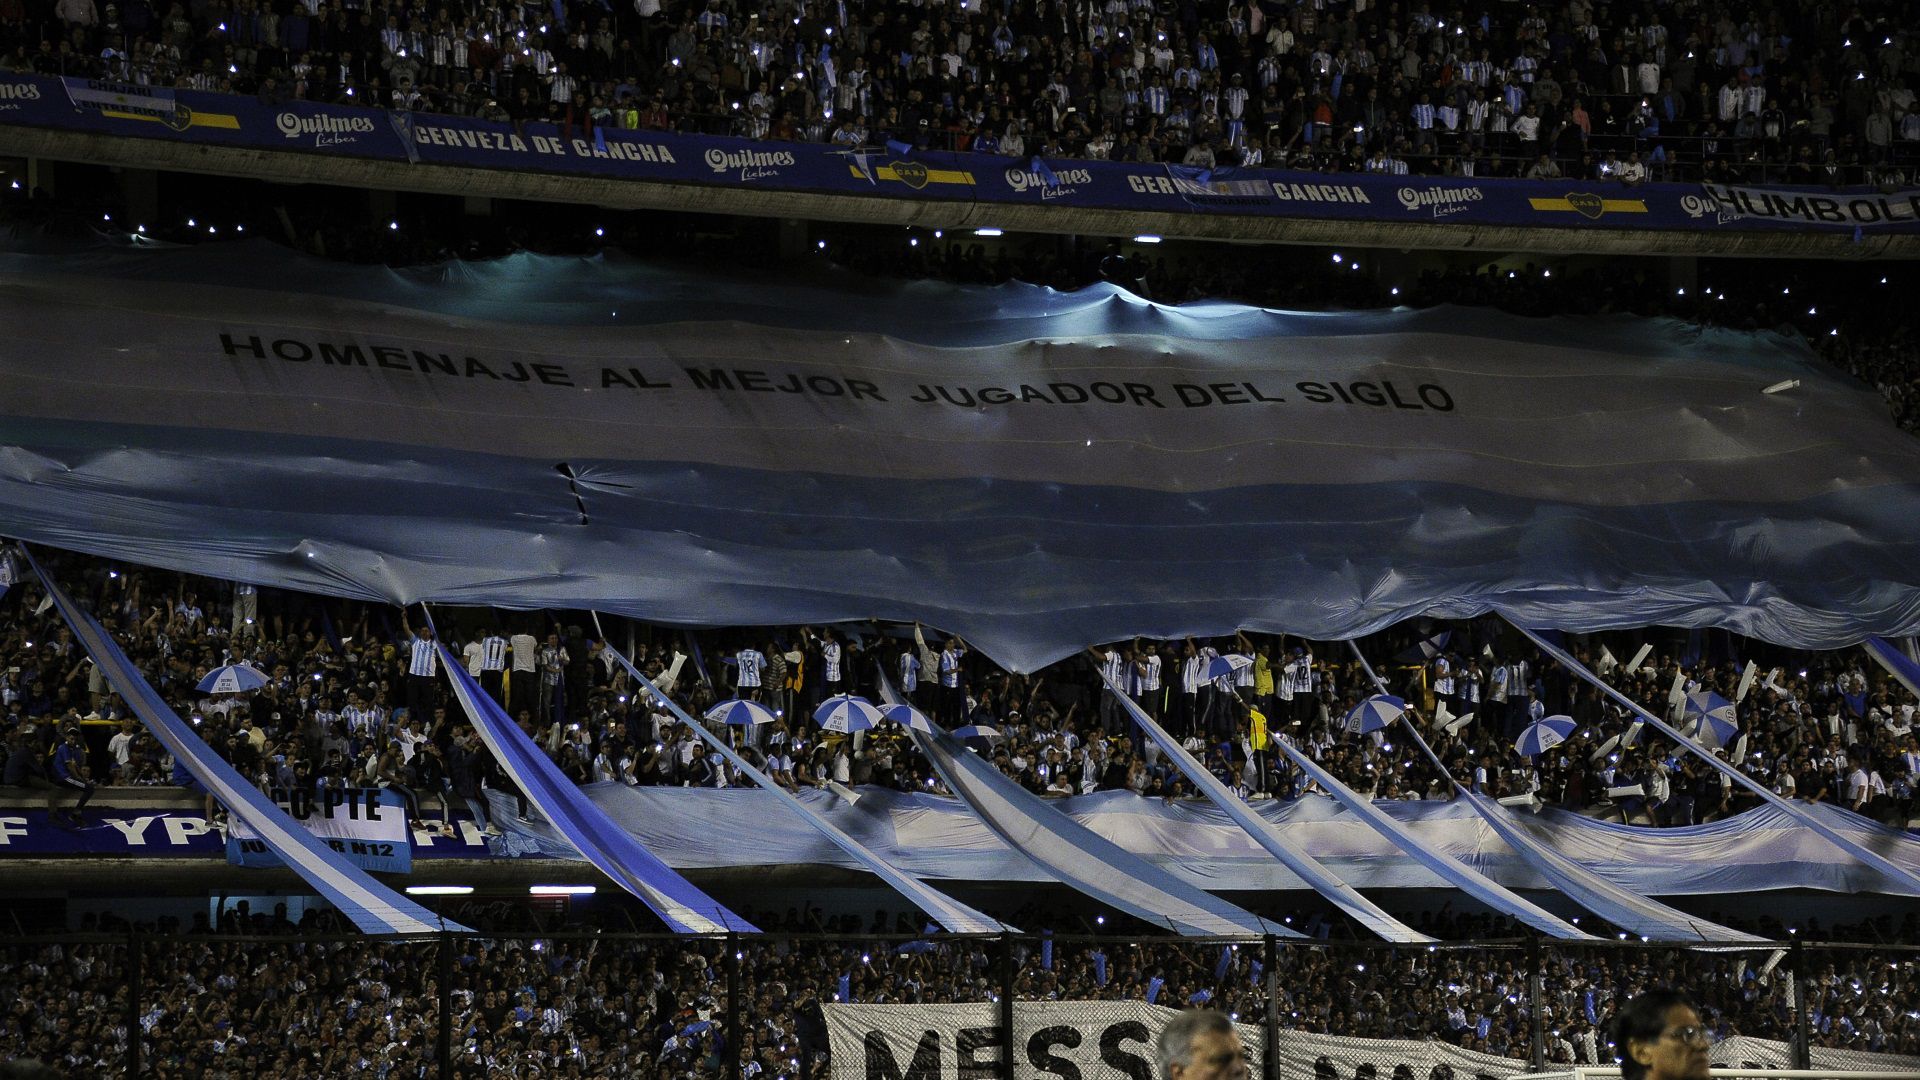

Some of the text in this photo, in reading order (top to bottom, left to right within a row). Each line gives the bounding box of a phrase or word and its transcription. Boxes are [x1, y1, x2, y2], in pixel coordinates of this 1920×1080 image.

[276, 111, 375, 138] Quilmes
[315, 132, 358, 147] Lieber
[416, 126, 677, 164] CERVEZA DE CANCHA
[704, 147, 795, 173] Quilmes
[741, 166, 780, 181] Lieber
[1005, 168, 1092, 192] Quimes
[1041, 186, 1077, 200] Lieber
[1273, 182, 1372, 204] CANCHA
[1397, 184, 1484, 211] Quilmes
[1432, 203, 1470, 218] Lieber
[218, 333, 1455, 413] HOMENAJE AL MEJOR JUGADOR DEL SIGLO
[325, 788, 381, 821] PTE
[864, 1021, 1253, 1080] MESS
